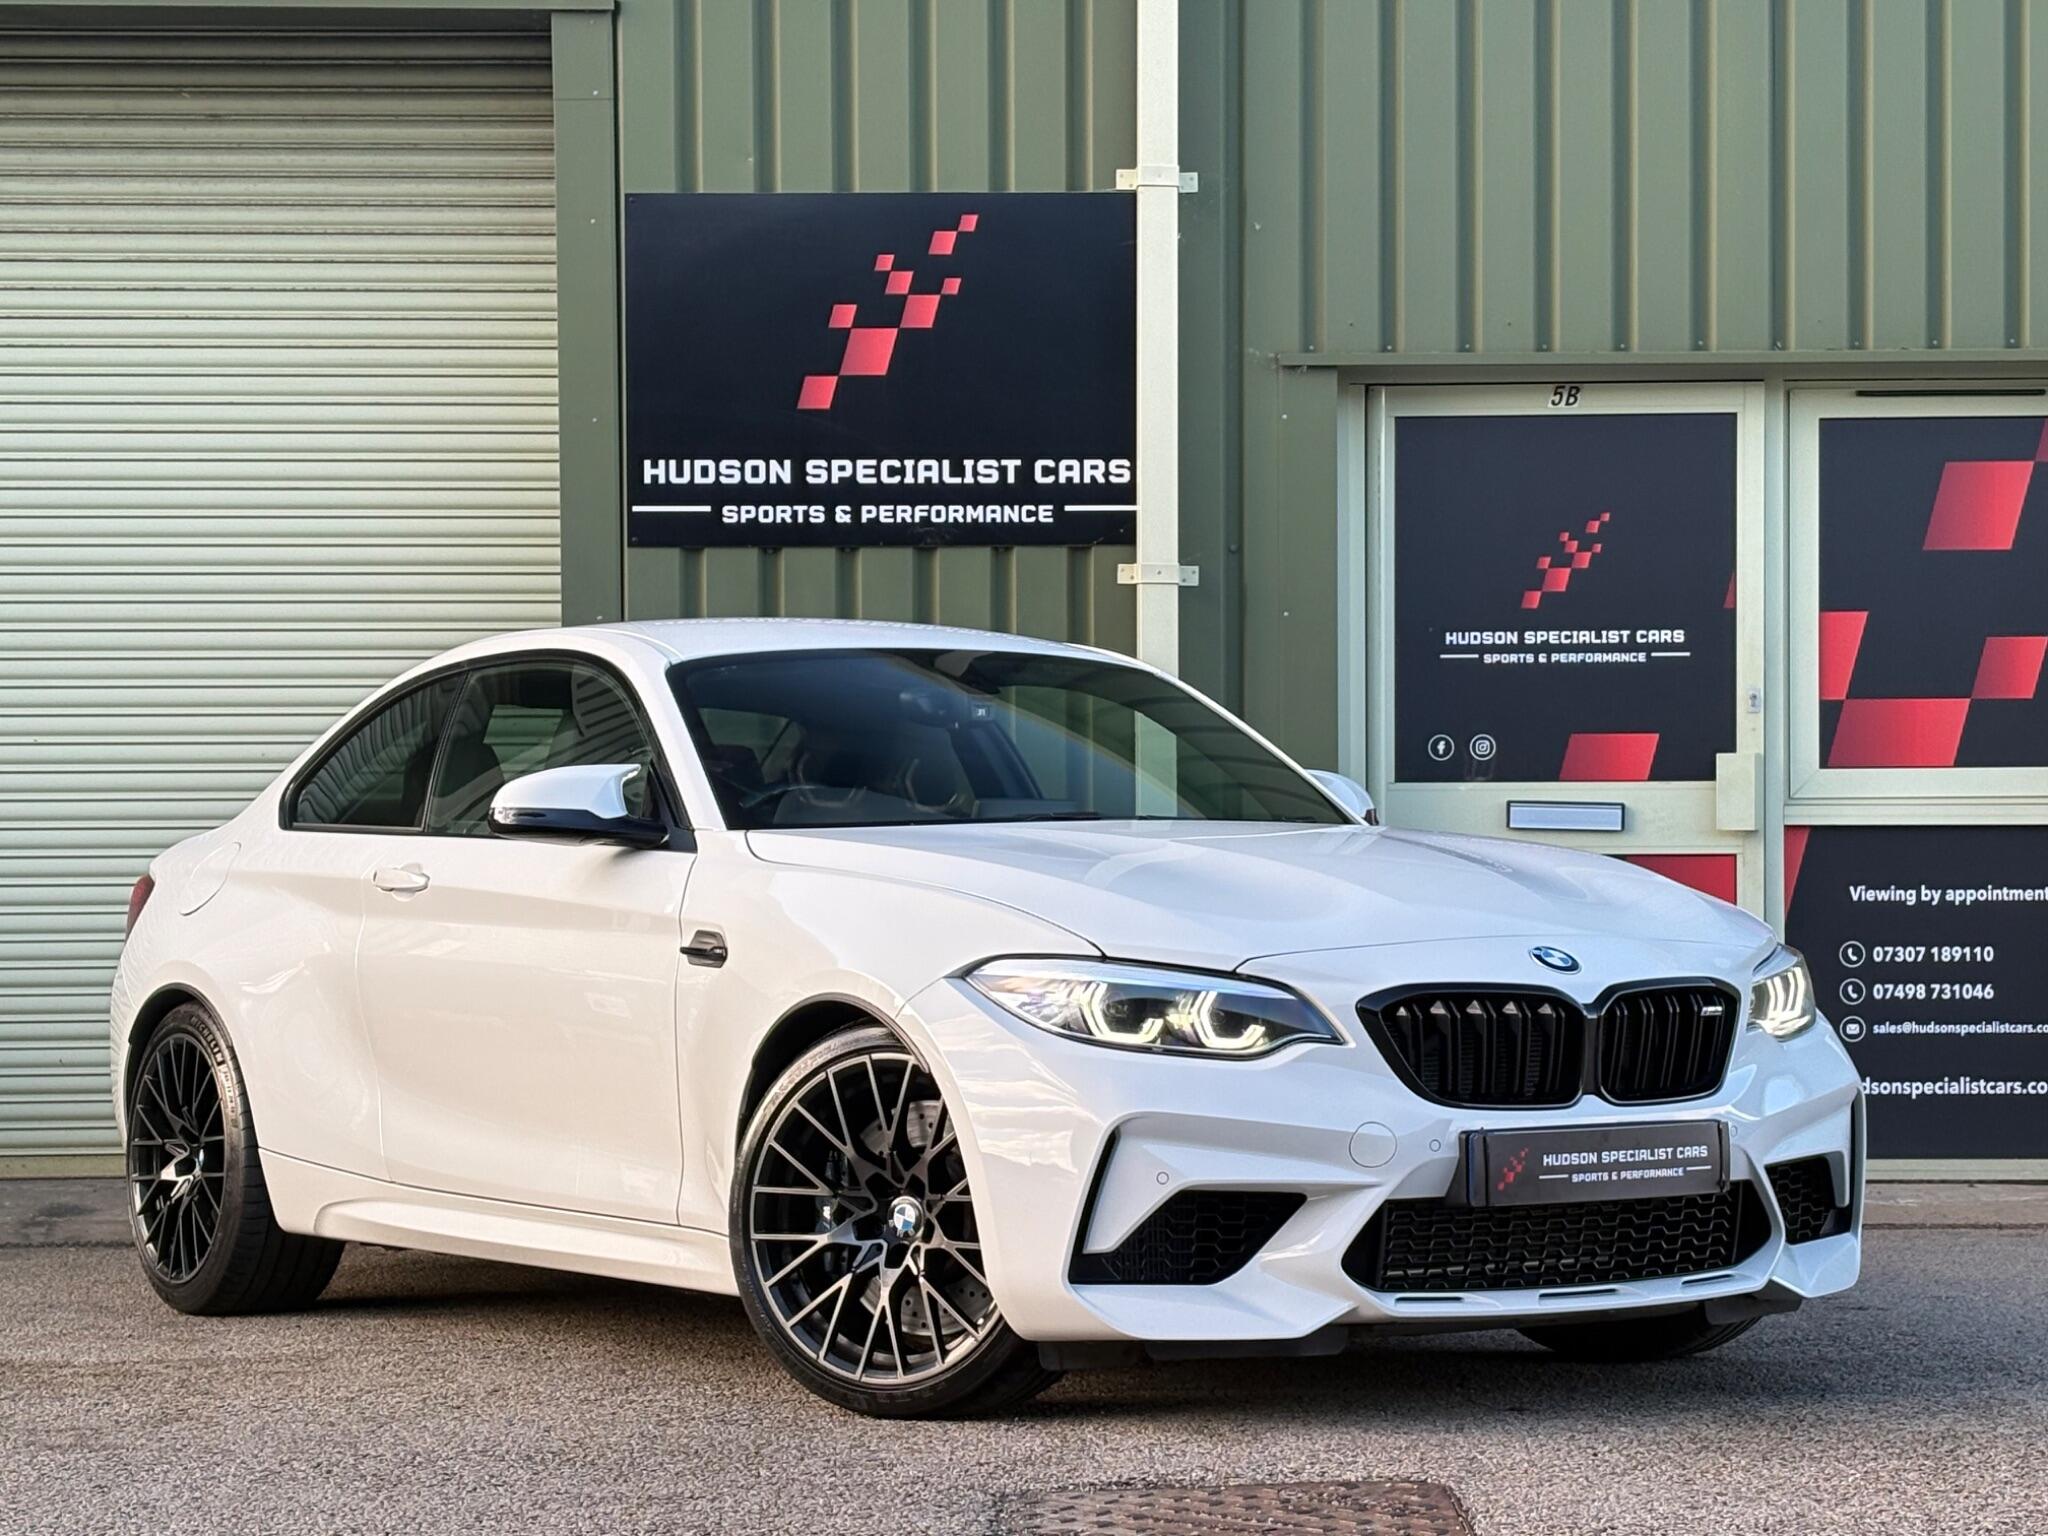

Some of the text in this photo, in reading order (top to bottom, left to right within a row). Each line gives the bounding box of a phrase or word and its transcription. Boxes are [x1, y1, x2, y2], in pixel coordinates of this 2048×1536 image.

[1551, 385, 1581, 406] 5B
[643, 458, 1131, 485] HUDSON SPECIALIST CARS
[721, 504, 1054, 524] SPORTS & PERFORMANCE
[1445, 629, 1686, 645] HUDSON SPECIALIST CARS
[1483, 651, 1647, 664] SPORTS & PERFORMANCE
[1849, 884, 2048, 906] Viewing by appointment
[1872, 945, 1995, 963] 07307 189110
[1872, 983, 1995, 1000] 07498 731046
[1542, 1144, 1709, 1167] HUDSON SPECIALIST CARS
[1571, 1171, 1610, 1183] SPORTS
[1619, 1166, 1685, 1181] PERFORMANCE
